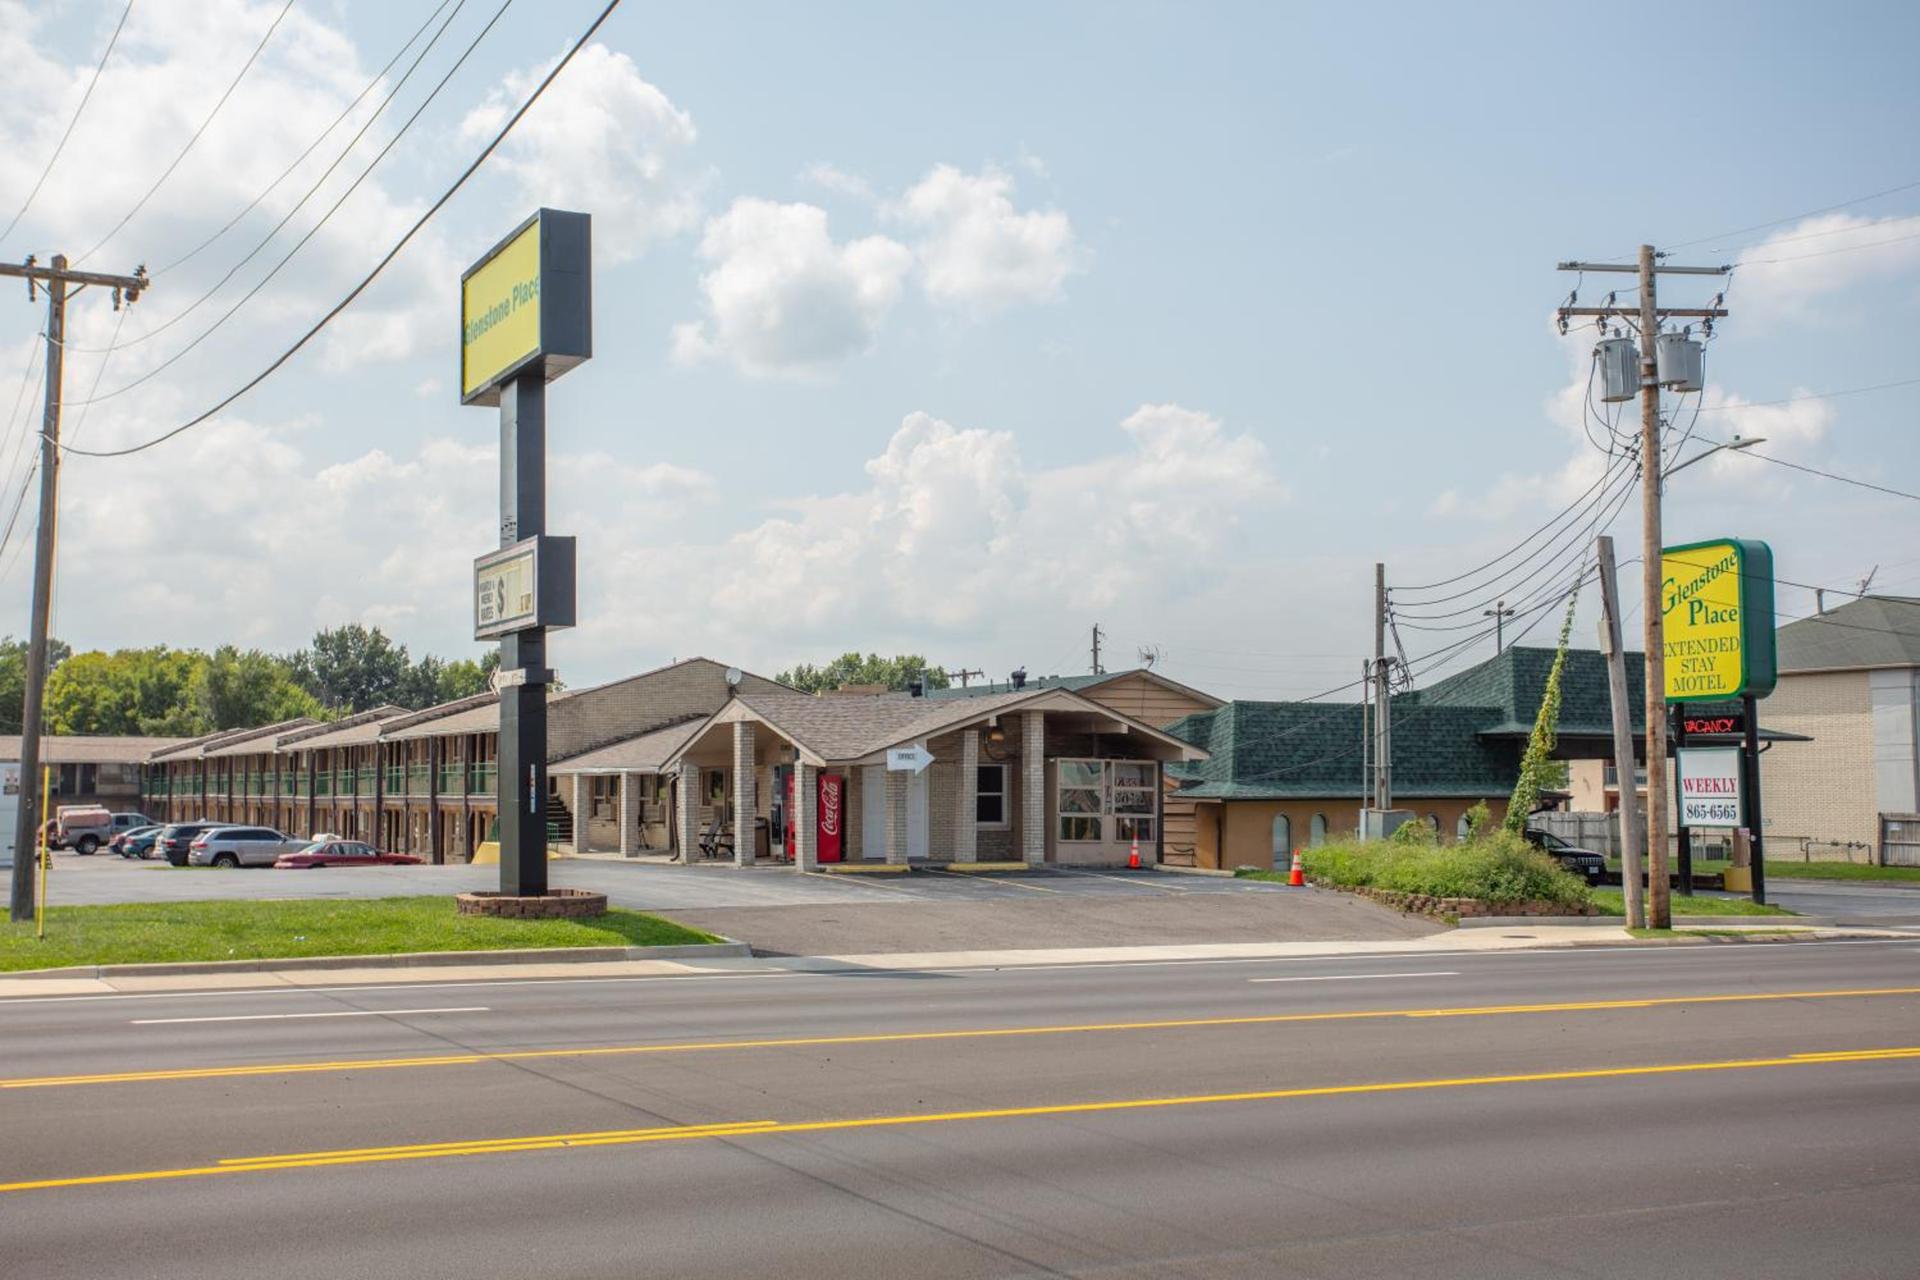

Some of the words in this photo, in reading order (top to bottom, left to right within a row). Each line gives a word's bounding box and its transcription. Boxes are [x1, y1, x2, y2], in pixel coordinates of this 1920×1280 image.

[464, 297, 510, 346] Glenstone
[512, 275, 540, 312] Place
[1661, 551, 1737, 615] Glenstone
[1687, 598, 1738, 626] Place
[1681, 656, 1716, 674] STAY
[1673, 674, 1726, 692] MOTEL
[1684, 719, 1734, 733] VACANCY
[1683, 778, 1736, 793] WEEKLY
[1686, 803, 1736, 820] 865-6565
